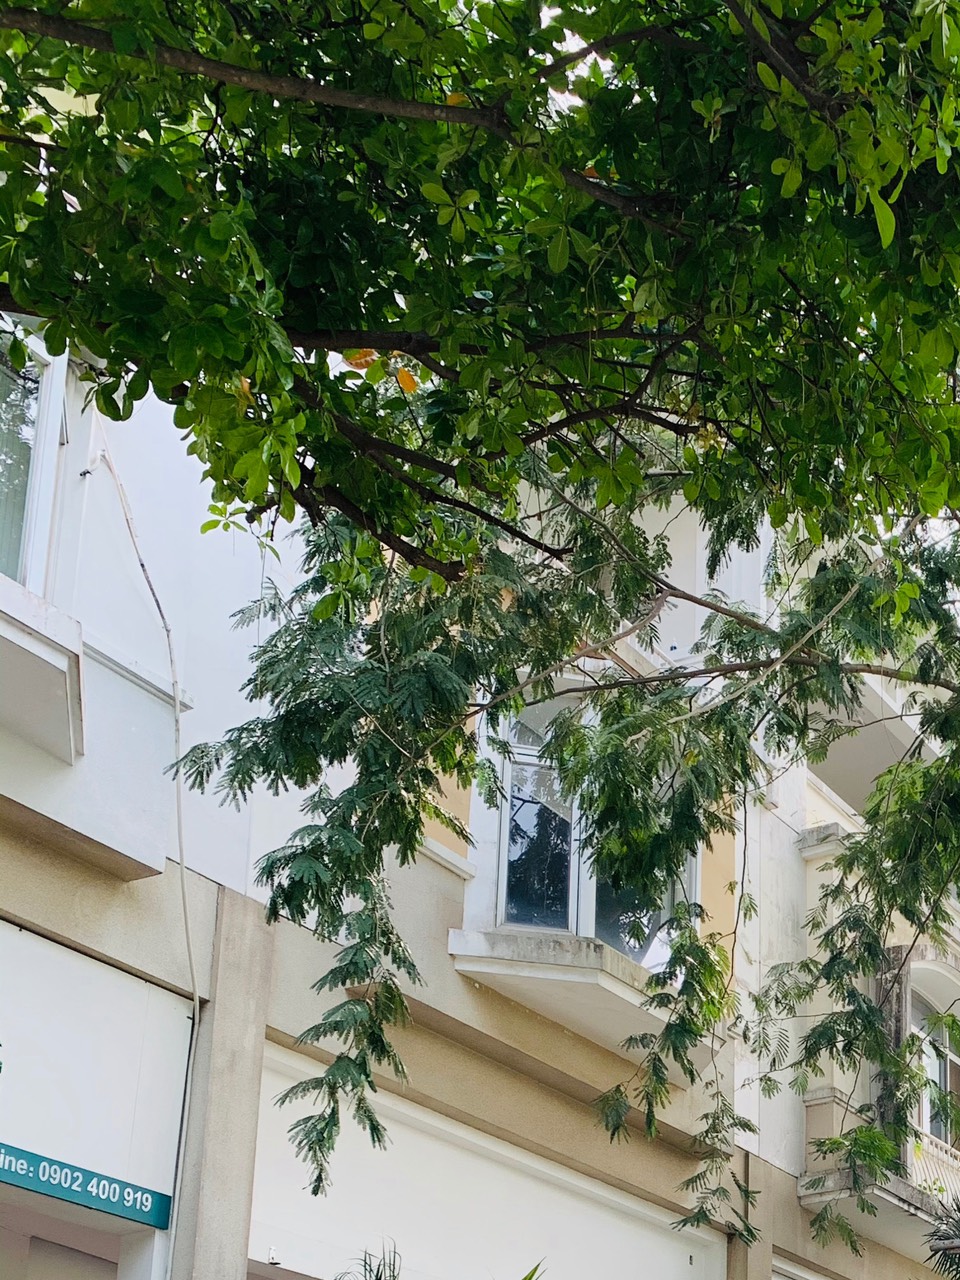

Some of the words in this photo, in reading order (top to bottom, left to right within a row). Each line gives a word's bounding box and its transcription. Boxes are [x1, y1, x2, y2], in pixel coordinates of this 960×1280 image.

[38, 1161, 83, 1192] 0902
[86, 1177, 120, 1203] 400
[123, 1187, 152, 1212] 919
